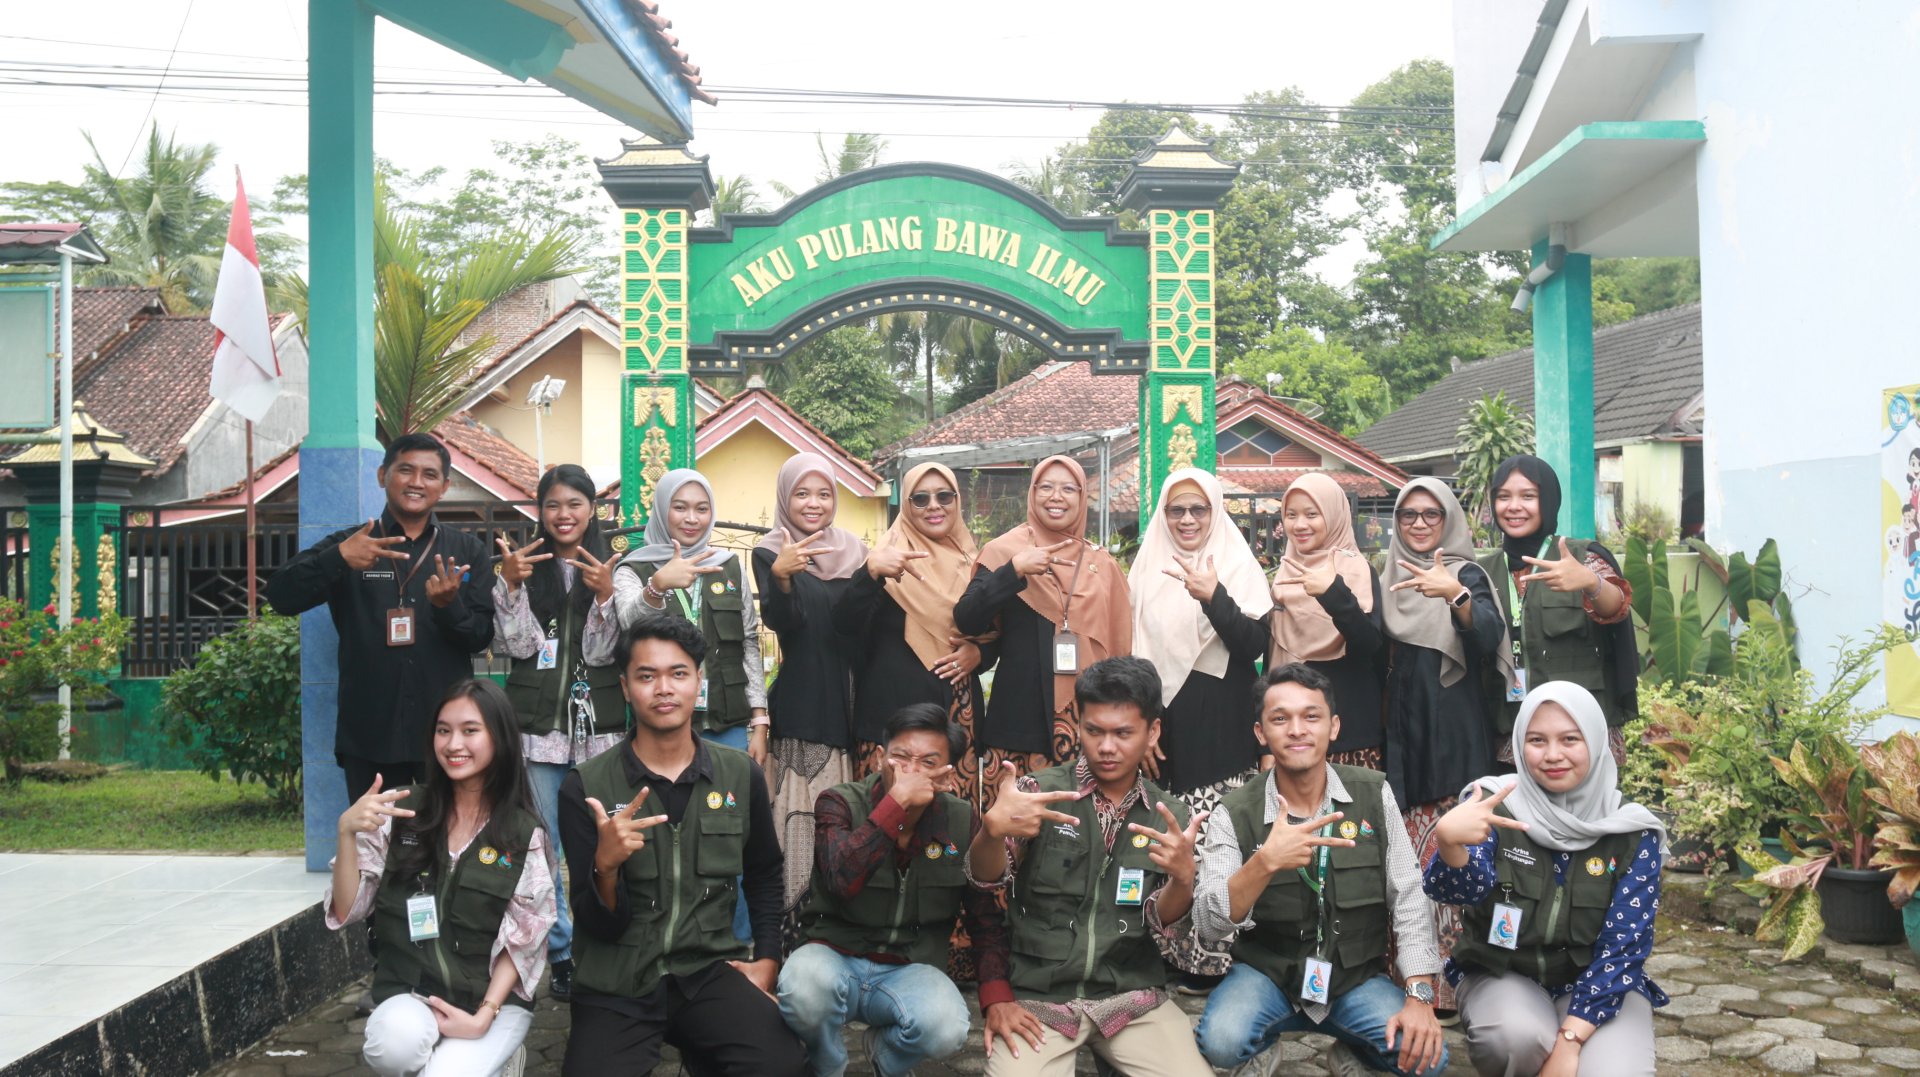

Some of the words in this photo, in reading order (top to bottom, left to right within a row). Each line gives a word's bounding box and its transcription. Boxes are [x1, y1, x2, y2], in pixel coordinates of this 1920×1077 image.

[730, 246, 795, 307] AKU
[797, 216, 922, 270] PULANG
[934, 217, 1022, 268] BAWA
[1026, 243, 1107, 306] ILMU
